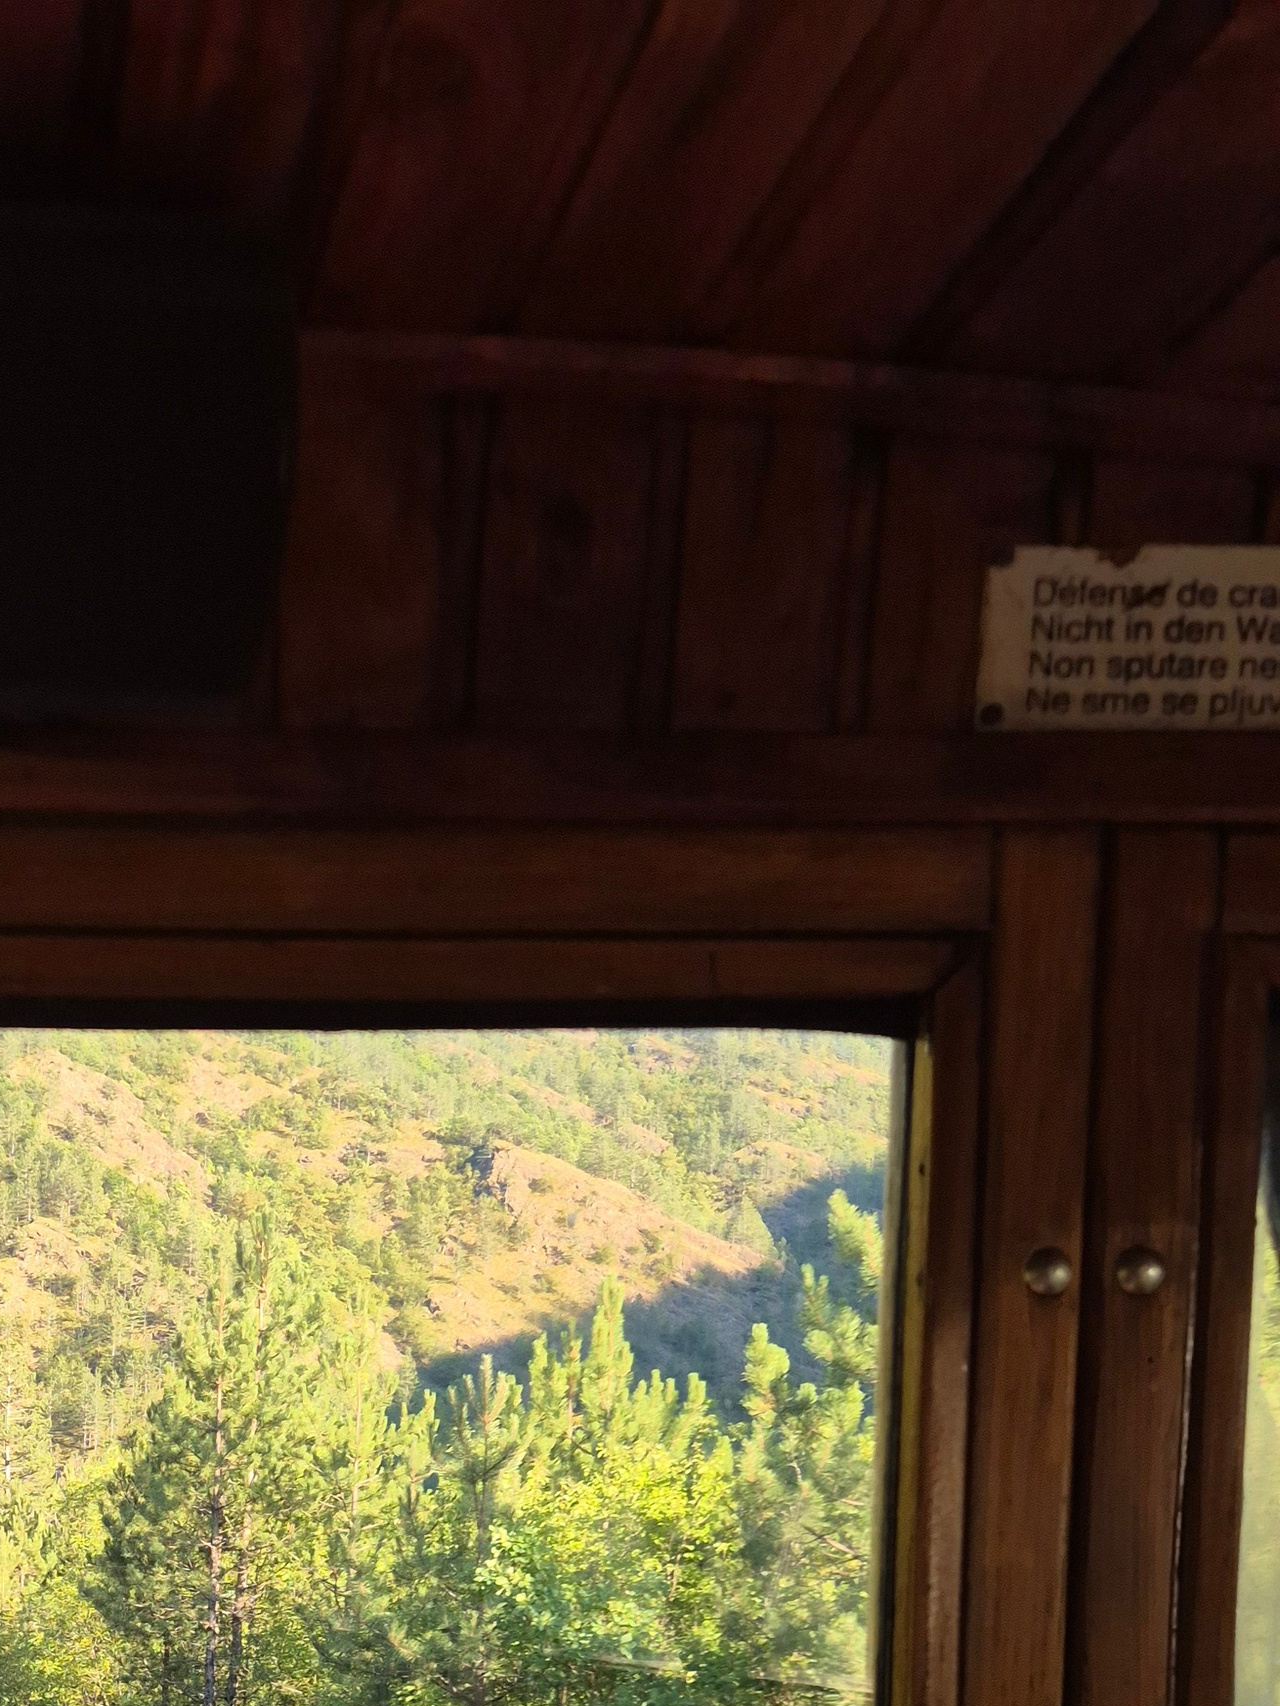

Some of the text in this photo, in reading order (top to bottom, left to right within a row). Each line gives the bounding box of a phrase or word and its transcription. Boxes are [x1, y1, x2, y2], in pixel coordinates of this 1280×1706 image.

[1176, 579, 1218, 608] de
[1227, 584, 1280, 608] cra
[1031, 615, 1114, 642] Nicht
[1125, 615, 1153, 642] in
[1163, 617, 1225, 643] den
[1028, 651, 1095, 679] Non
[1106, 654, 1227, 683] sputare
[1025, 687, 1071, 714] Ne
[1079, 692, 1149, 714] sme
[1160, 692, 1198, 714] se
